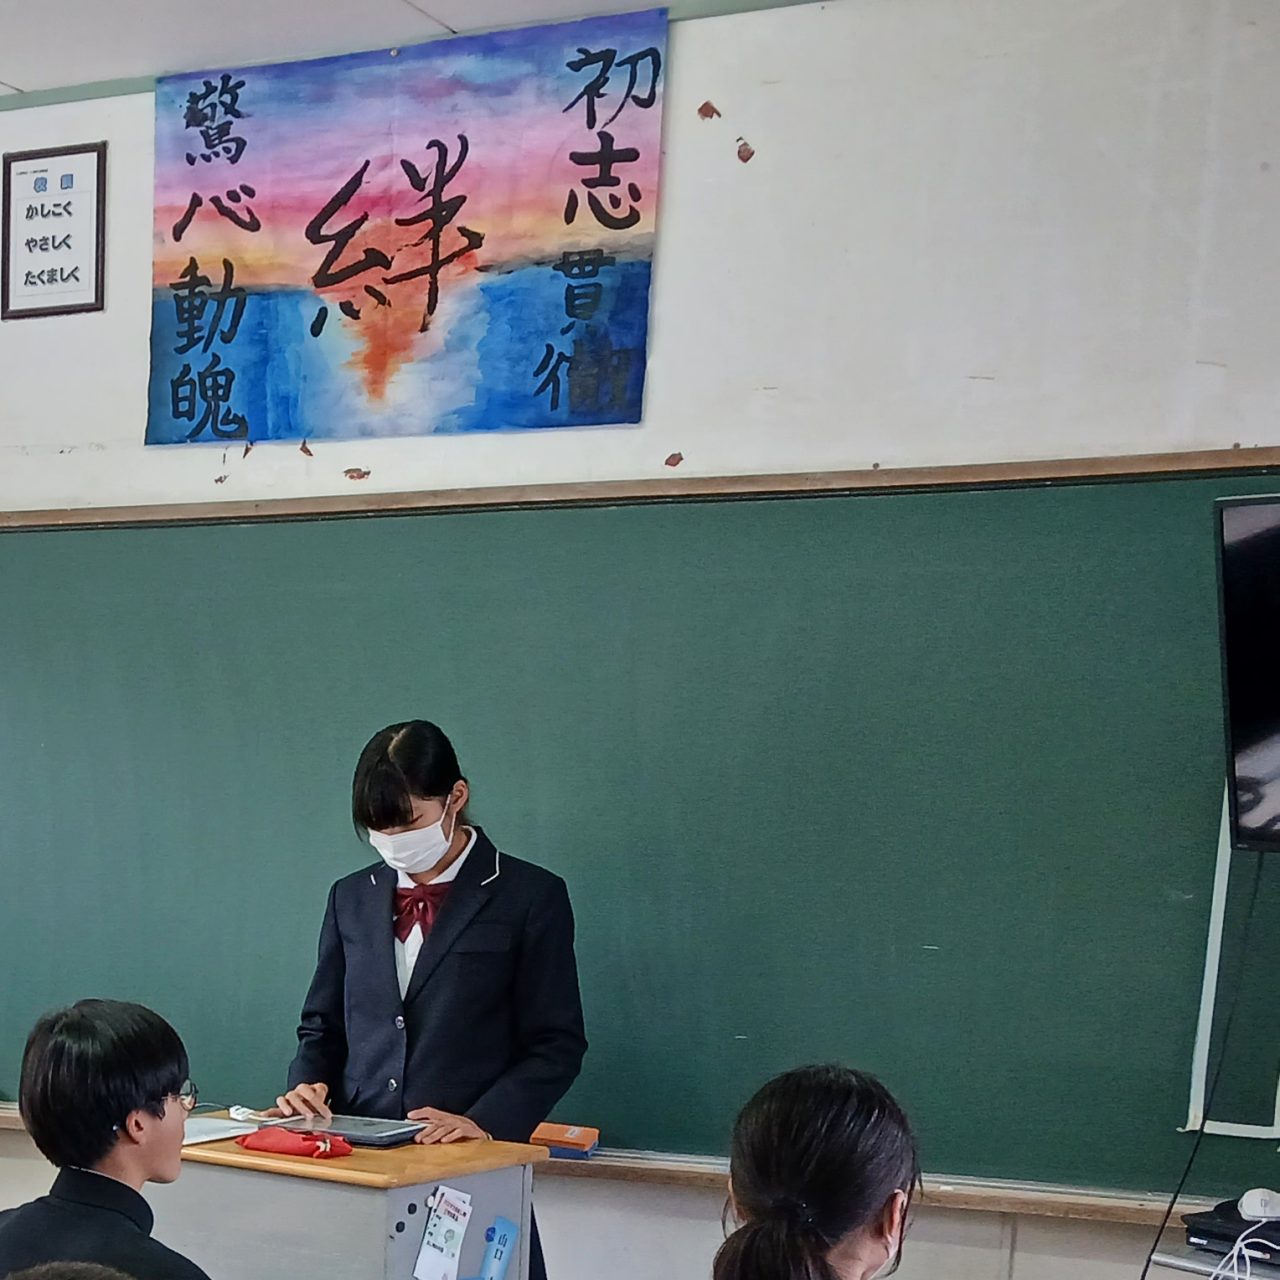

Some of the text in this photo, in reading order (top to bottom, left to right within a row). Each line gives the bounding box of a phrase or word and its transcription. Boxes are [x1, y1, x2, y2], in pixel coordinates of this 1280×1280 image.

[25, 201, 73, 220] かしこく
[25, 234, 73, 254] やさしく
[307, 134, 486, 337] 絆
[24, 266, 80, 287] たくましく
[493, 1233, 507, 1261] 山口
